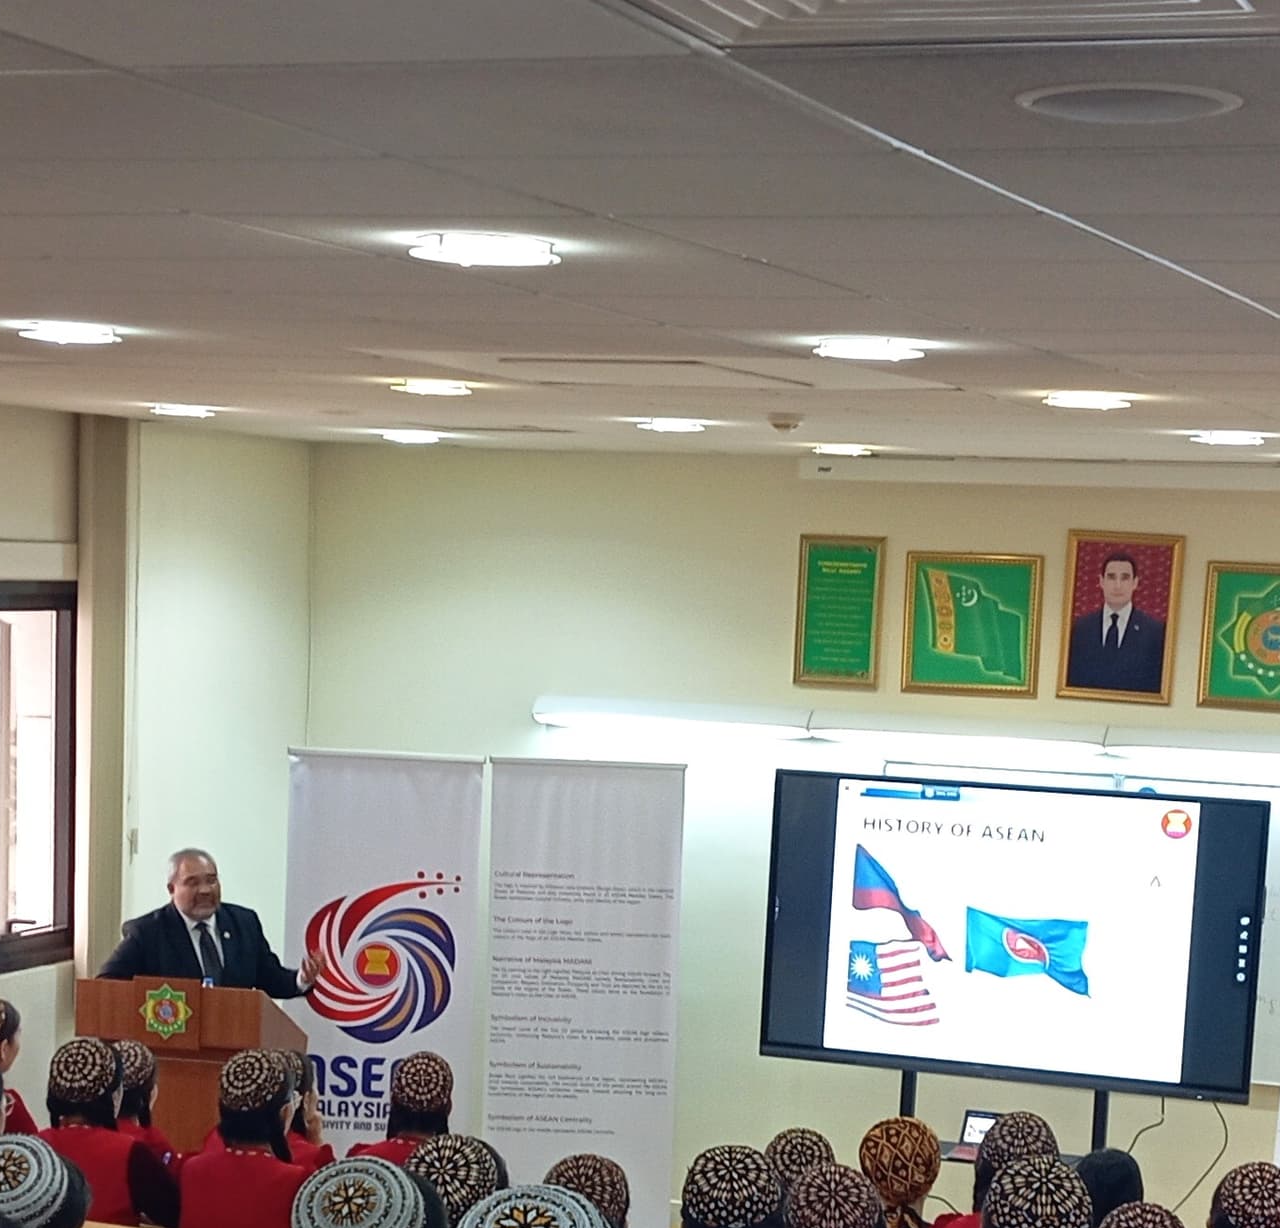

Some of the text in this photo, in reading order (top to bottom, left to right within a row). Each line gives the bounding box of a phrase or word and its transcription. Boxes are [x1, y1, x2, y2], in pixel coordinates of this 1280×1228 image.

[863, 817, 1045, 843] HISTORY OF ASEAN
[317, 1100, 391, 1118] ALAYSIA
